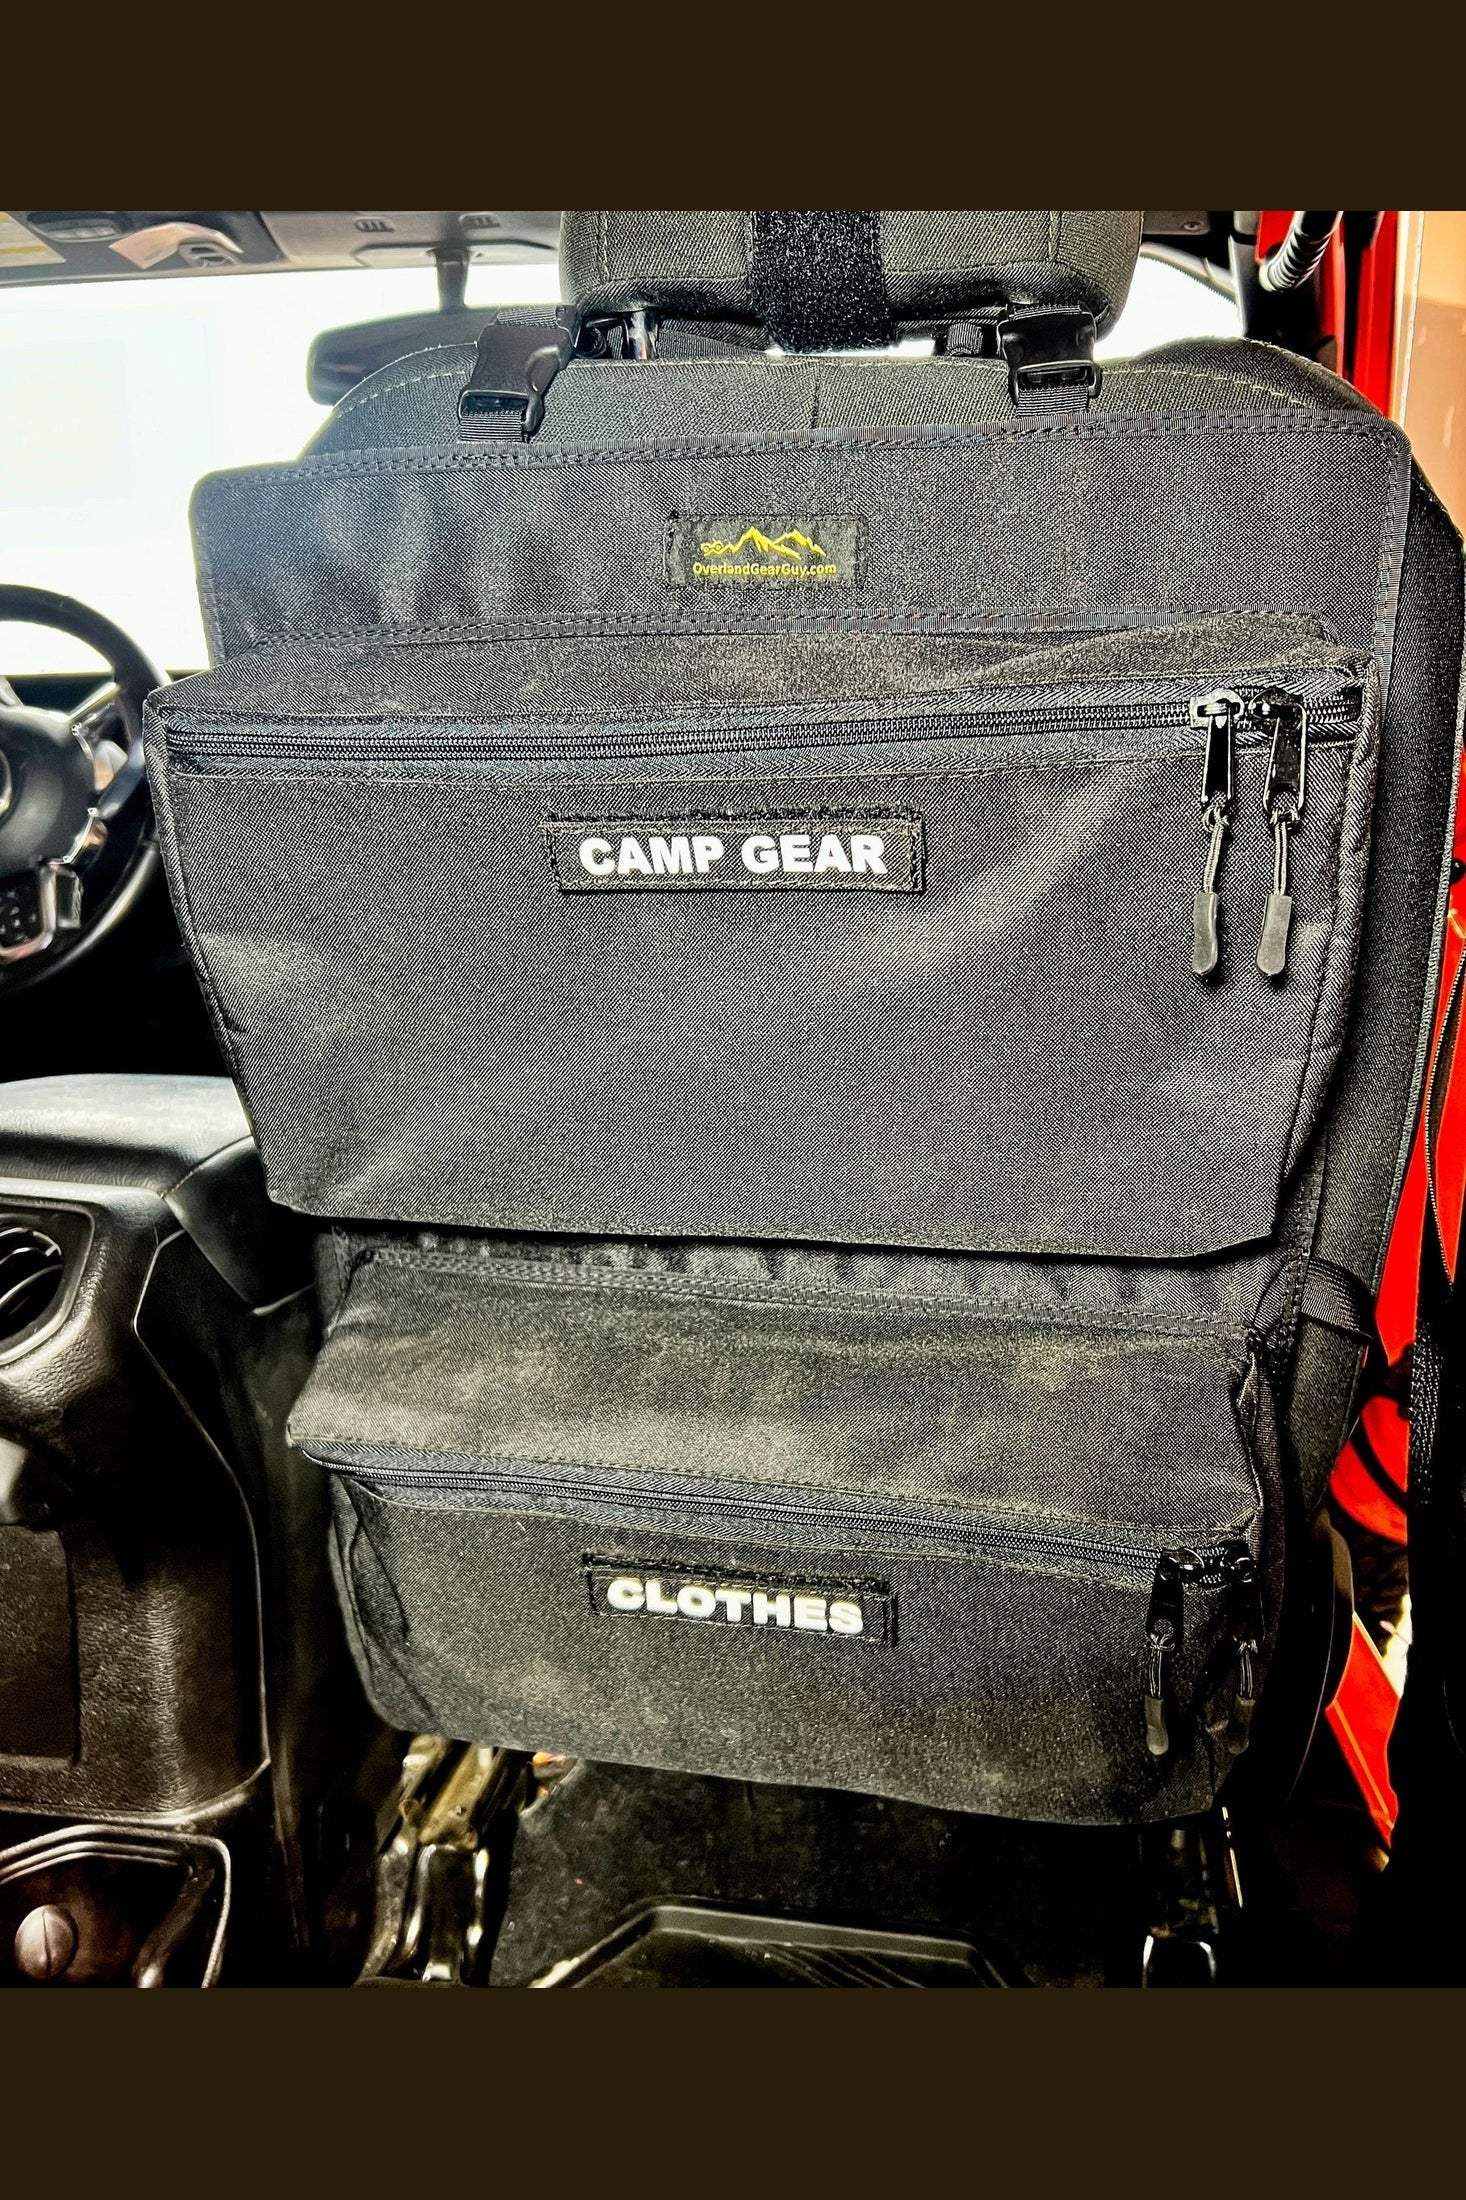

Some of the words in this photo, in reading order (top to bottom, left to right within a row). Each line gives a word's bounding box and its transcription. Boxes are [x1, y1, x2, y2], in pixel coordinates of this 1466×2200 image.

[692, 561, 837, 577] OverlandGearGuy.com
[578, 836, 724, 876] CAMP
[741, 834, 888, 875] GEAR
[606, 1577, 864, 1635] CLOTHES
